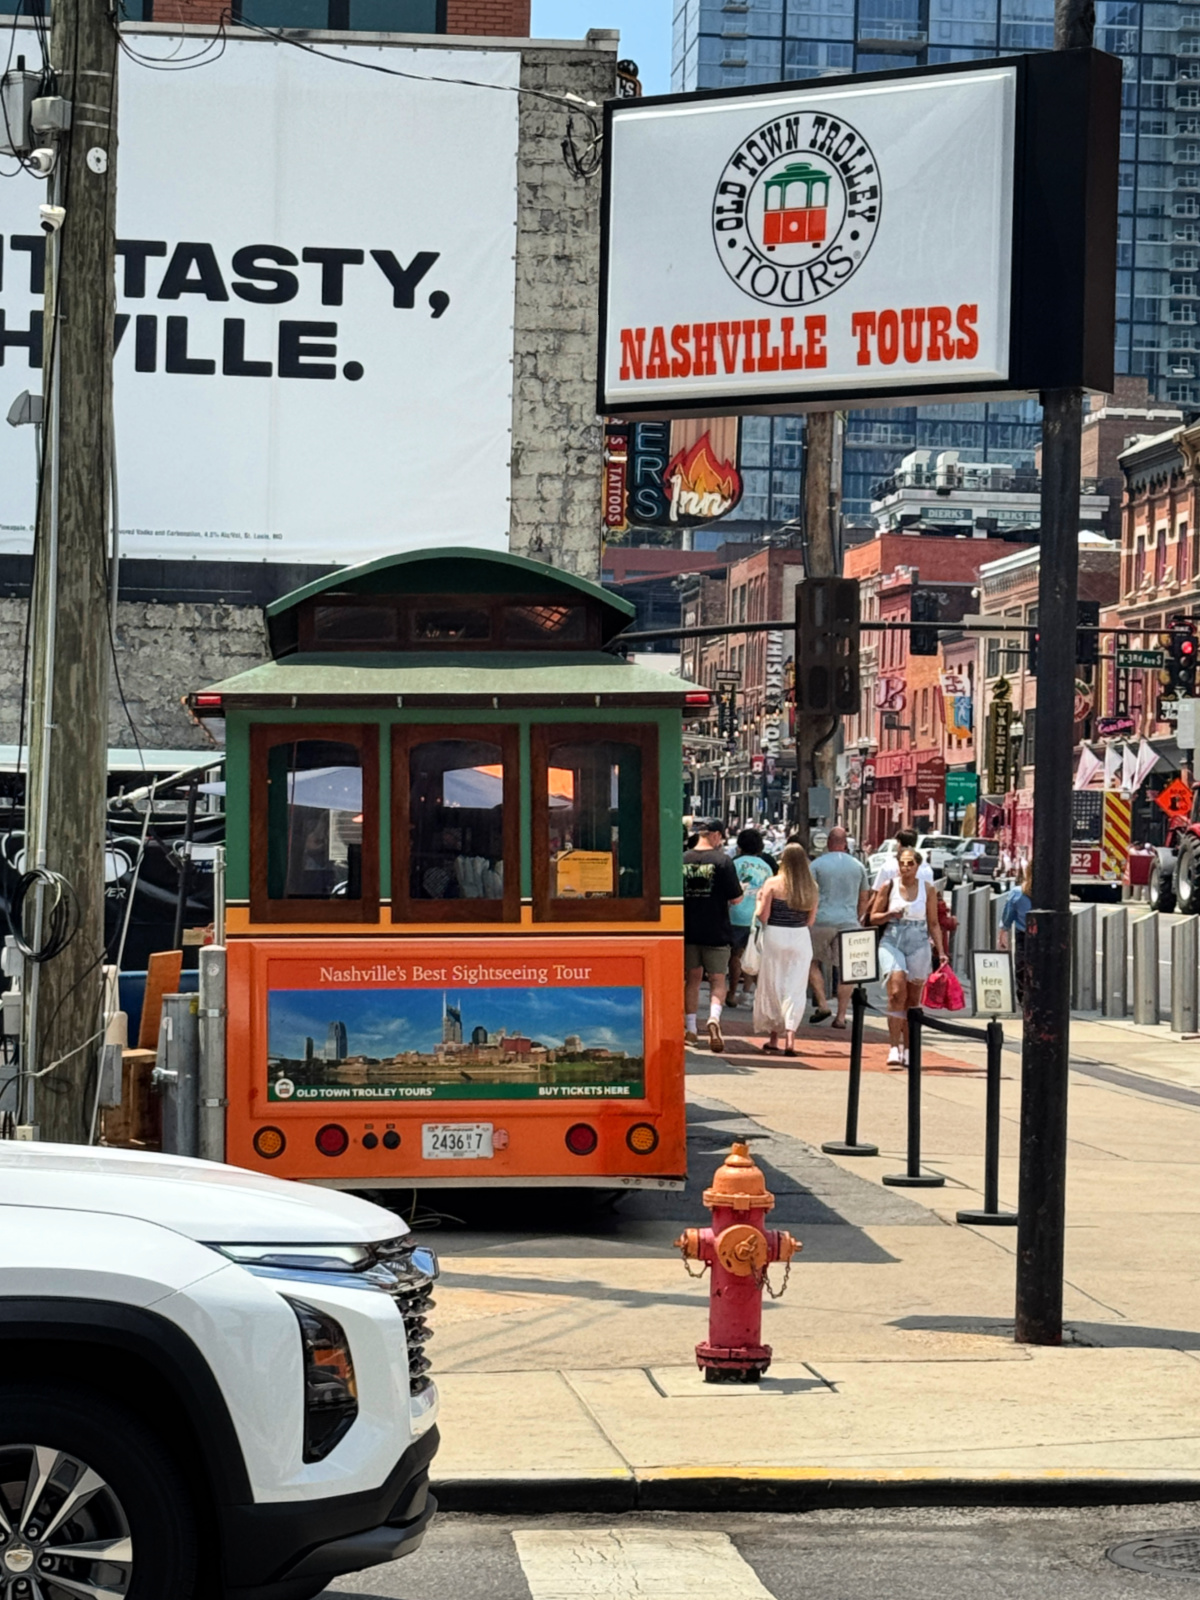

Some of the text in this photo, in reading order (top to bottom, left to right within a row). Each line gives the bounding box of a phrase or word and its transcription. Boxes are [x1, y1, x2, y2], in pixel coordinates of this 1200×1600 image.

[715, 115, 878, 231] OLD TOWN TROLLEY
[114, 239, 450, 319] TASTY,
[735, 245, 854, 303] TOURS
[619, 303, 979, 381] NASHVILLE TOURS
[608, 467, 622, 522] TATTOOS
[669, 473, 732, 522] Inn
[928, 509, 965, 519] DIERKS
[1118, 633, 1127, 713] MANDA
[995, 707, 1007, 794] VALENTINE
[848, 936, 870, 946] Enter
[850, 950, 870, 959] Here
[319, 964, 593, 984] Nashville's Best Sightseeing Tour
[982, 958, 999, 968] Exit
[981, 975, 1003, 986] Here
[297, 1088, 317, 1098] OLD
[319, 1088, 351, 1098] TOWN
[352, 1087, 397, 1097] TROLLEY
[538, 1085, 630, 1096] BUY TICKETS HERE
